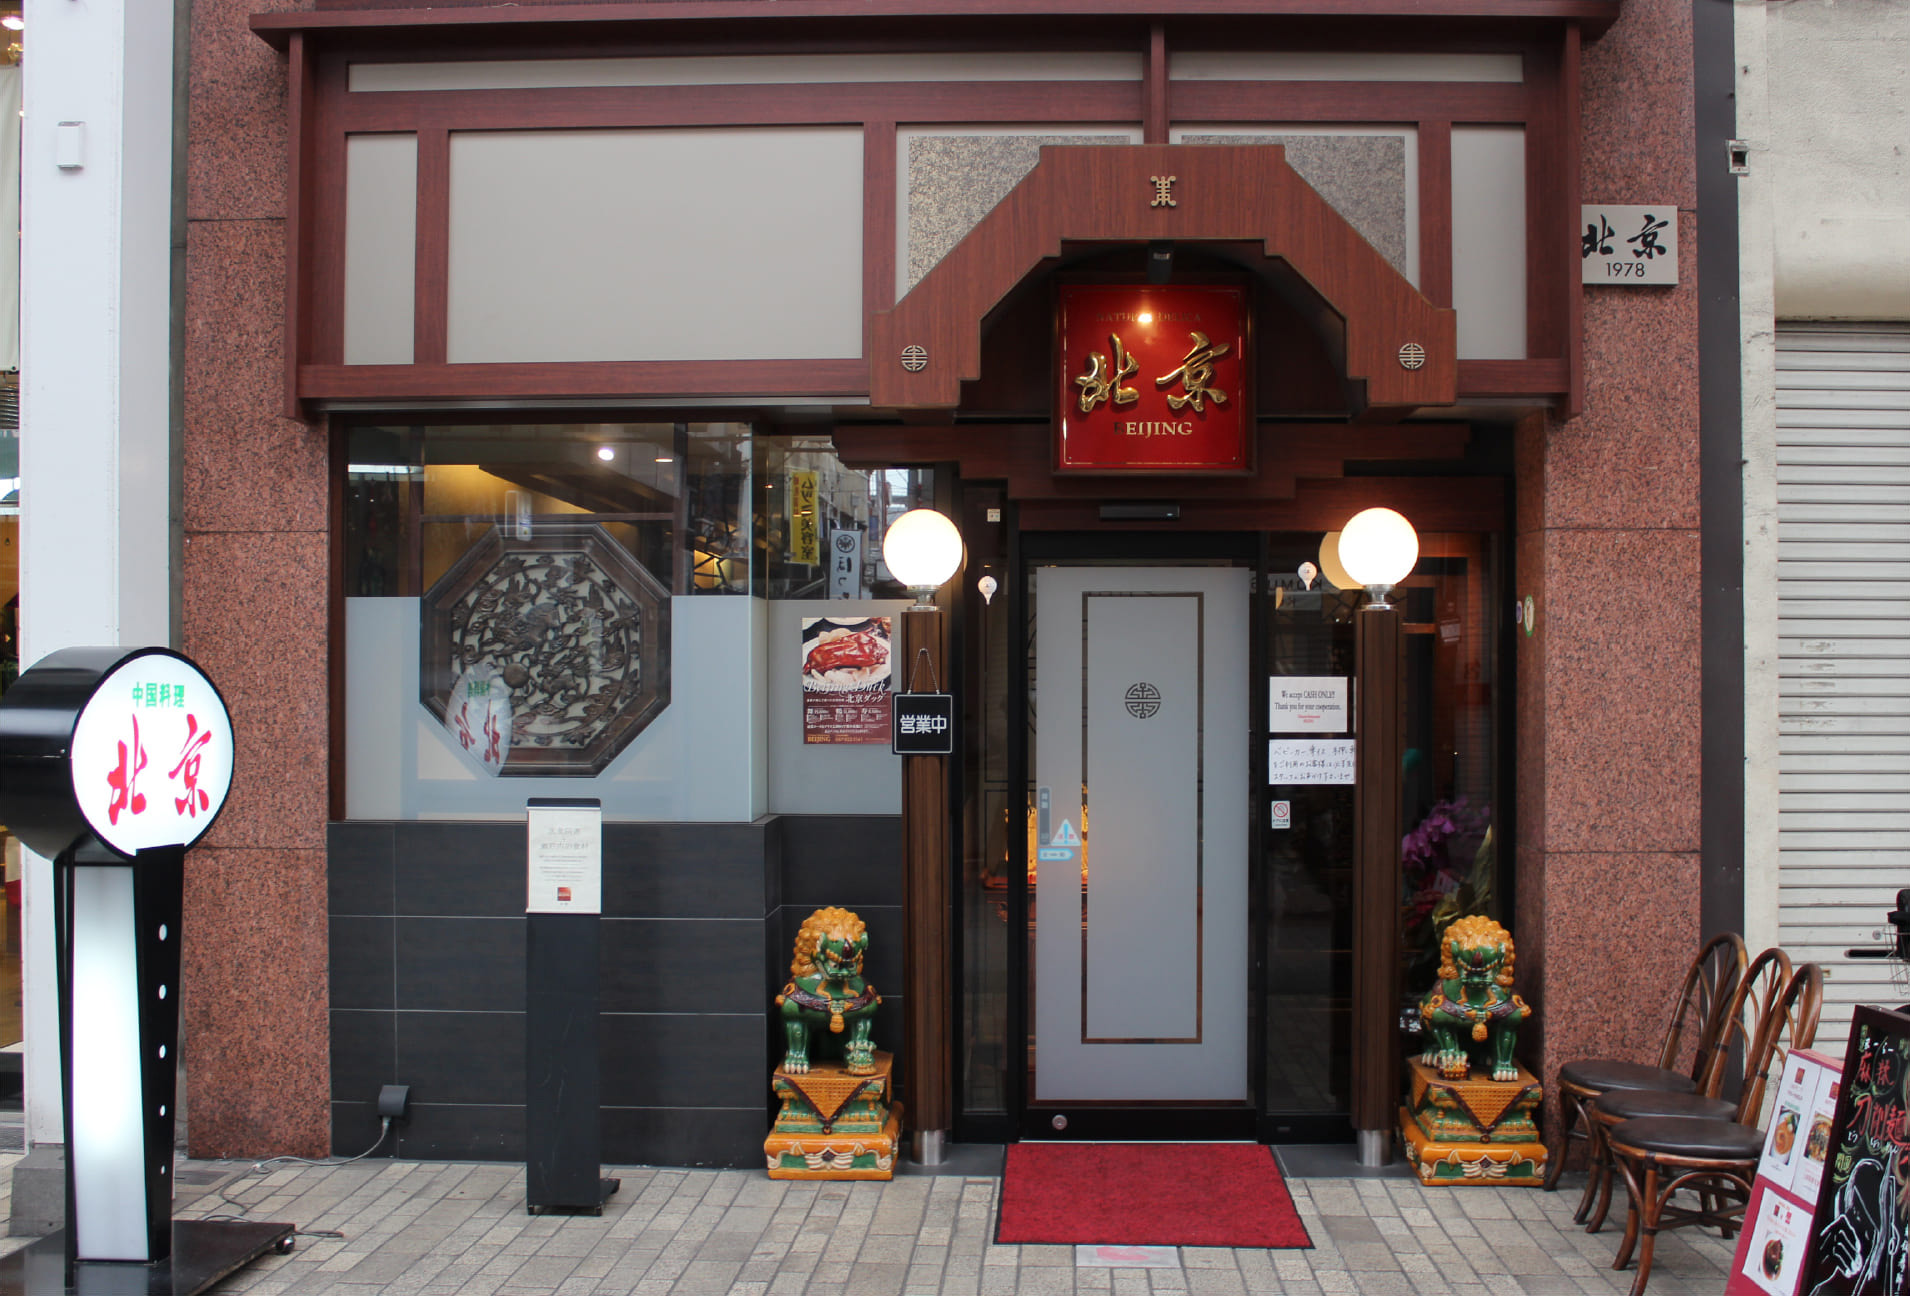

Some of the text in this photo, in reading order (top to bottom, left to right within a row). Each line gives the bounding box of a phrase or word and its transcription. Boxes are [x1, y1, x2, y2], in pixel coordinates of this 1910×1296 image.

[1582, 213, 1669, 259] 北京
[1606, 262, 1645, 277] 1978
[1074, 332, 1230, 412] 北京
[1114, 421, 1193, 438] BEIJING
[132, 682, 185, 707] 中国料理
[847, 693, 885, 704] 北京ダック
[900, 714, 947, 735] 営業中
[107, 713, 212, 826] 北京
[1855, 1051, 1896, 1087] 麻辣
